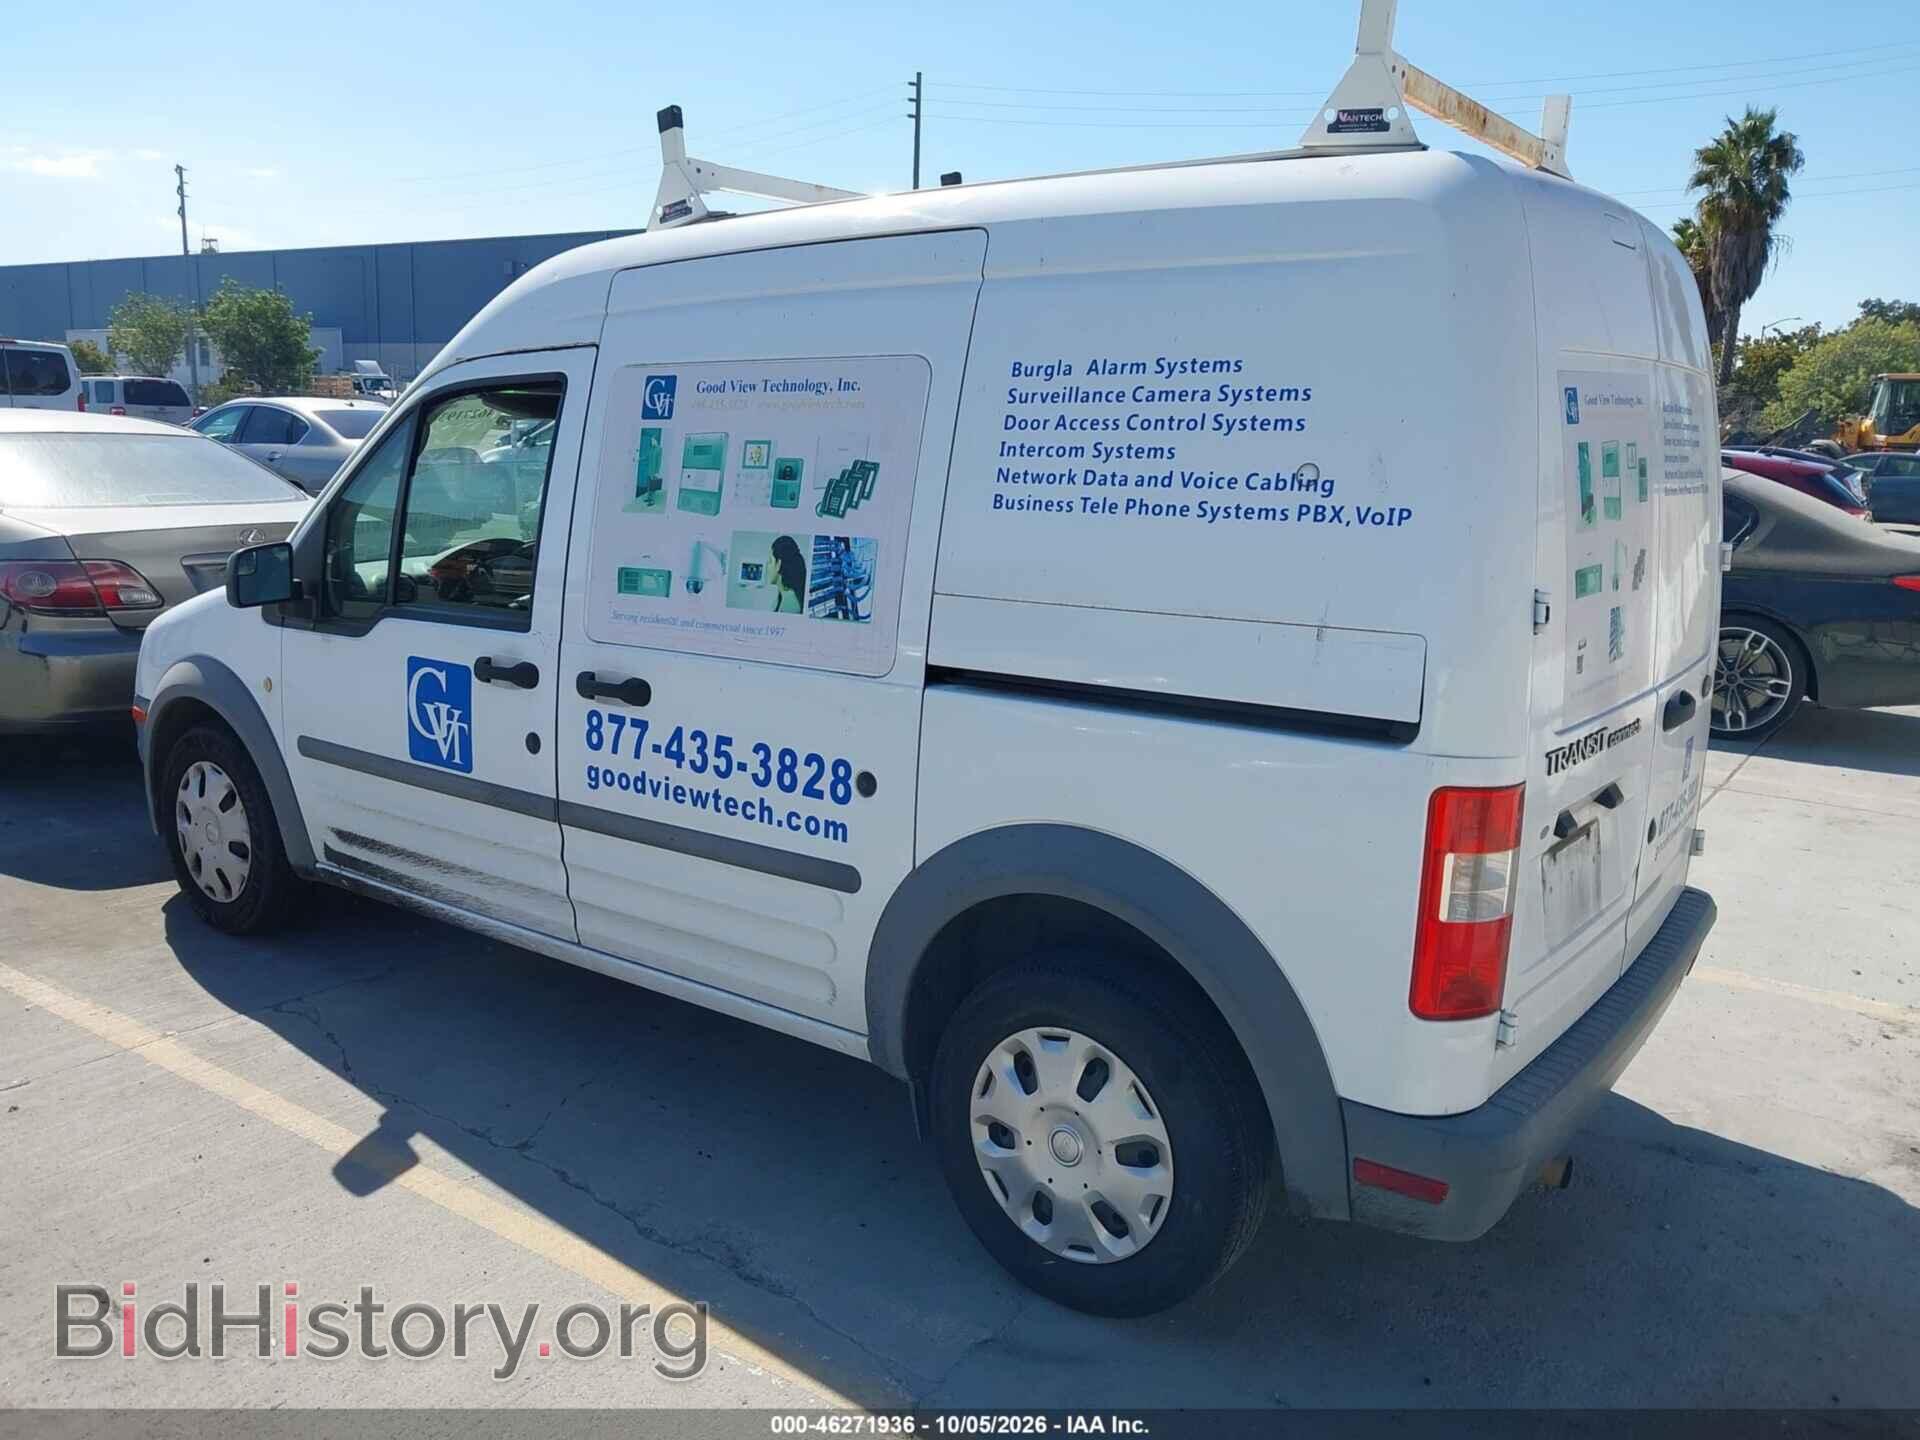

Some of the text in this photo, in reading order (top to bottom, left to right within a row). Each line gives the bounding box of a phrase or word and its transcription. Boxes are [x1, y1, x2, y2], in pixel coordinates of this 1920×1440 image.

[1011, 357, 1243, 382] Burgla Alarm Systems
[696, 377, 861, 396] Good View Technology, Inc.
[1007, 384, 1312, 407] Surveillance Camera Systems
[1003, 412, 1306, 436] Door Access Control Systems
[999, 441, 1176, 464] Intercom Systems
[996, 467, 1335, 498] Network Data and Voice Cabling
[992, 494, 1074, 513] Business
[1080, 496, 1119, 514] Tele
[1124, 498, 1190, 517] Phone
[1196, 500, 1289, 524] Systems
[585, 709, 853, 806] 877-435-3828
[586, 763, 848, 842] goodviewtech.com
